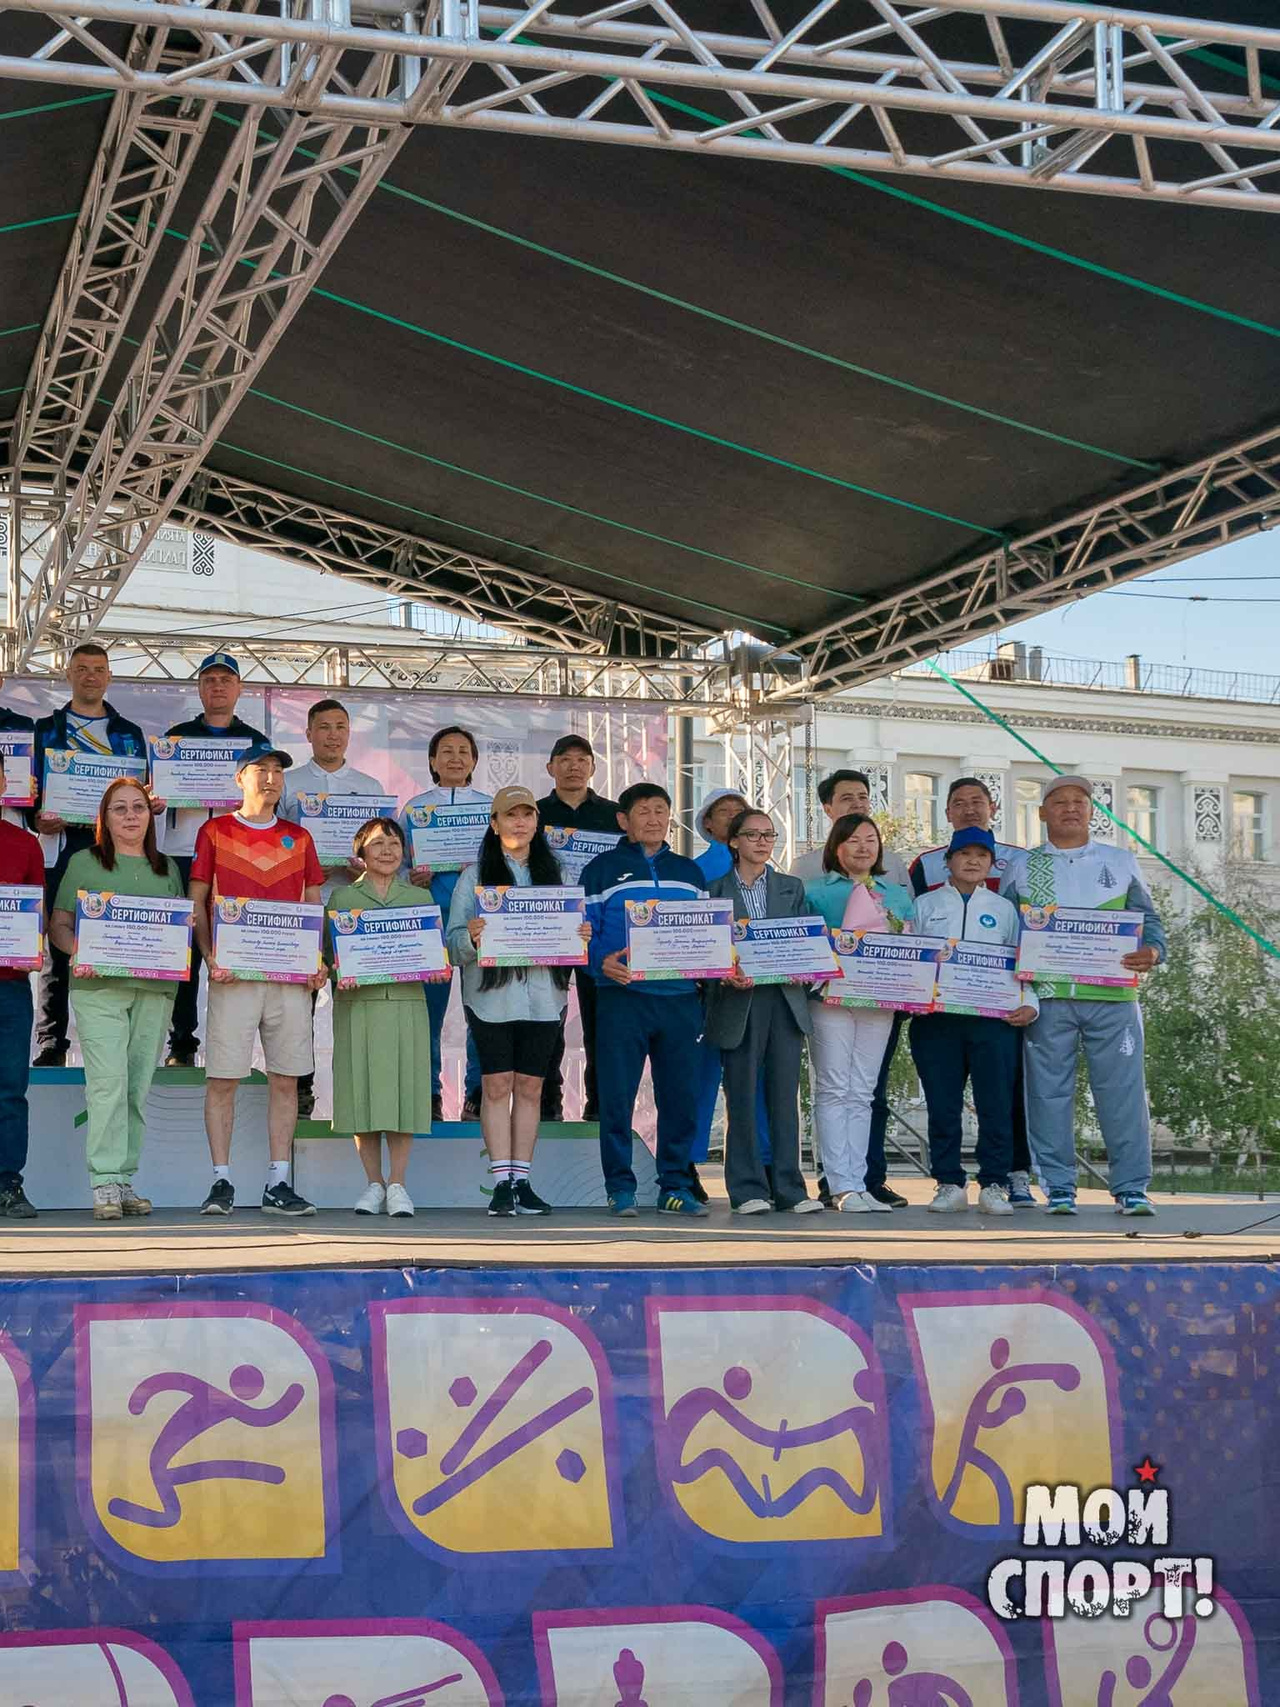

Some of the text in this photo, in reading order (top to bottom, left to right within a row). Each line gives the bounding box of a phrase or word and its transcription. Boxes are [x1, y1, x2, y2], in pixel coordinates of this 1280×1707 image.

[180, 749, 234, 761] СЕРТИФИКАТ
[75, 764, 128, 778] СЕРТИФИКАТ
[328, 807, 380, 819] СЕРТИФИКАТ
[437, 814, 490, 827] СЕРТИФИКАТ
[572, 841, 617, 854] СЕРТИФИ
[508, 901, 566, 912] СЕРТИФИКАТ
[111, 909, 172, 923] СЕРТИФИКАТ
[247, 913, 304, 928] СЕРТИФИКАТ
[658, 913, 714, 925] СЕРТИФИКАТ
[364, 919, 422, 933] СЕРТИФИКАТ
[1055, 921, 1120, 934] СЕРТИФИКАТ
[753, 927, 809, 940] СЕРТИФИКАТ
[863, 946, 922, 960] СЕРТИФИКАТ
[958, 953, 1007, 969] СЕРТИФИКАТ
